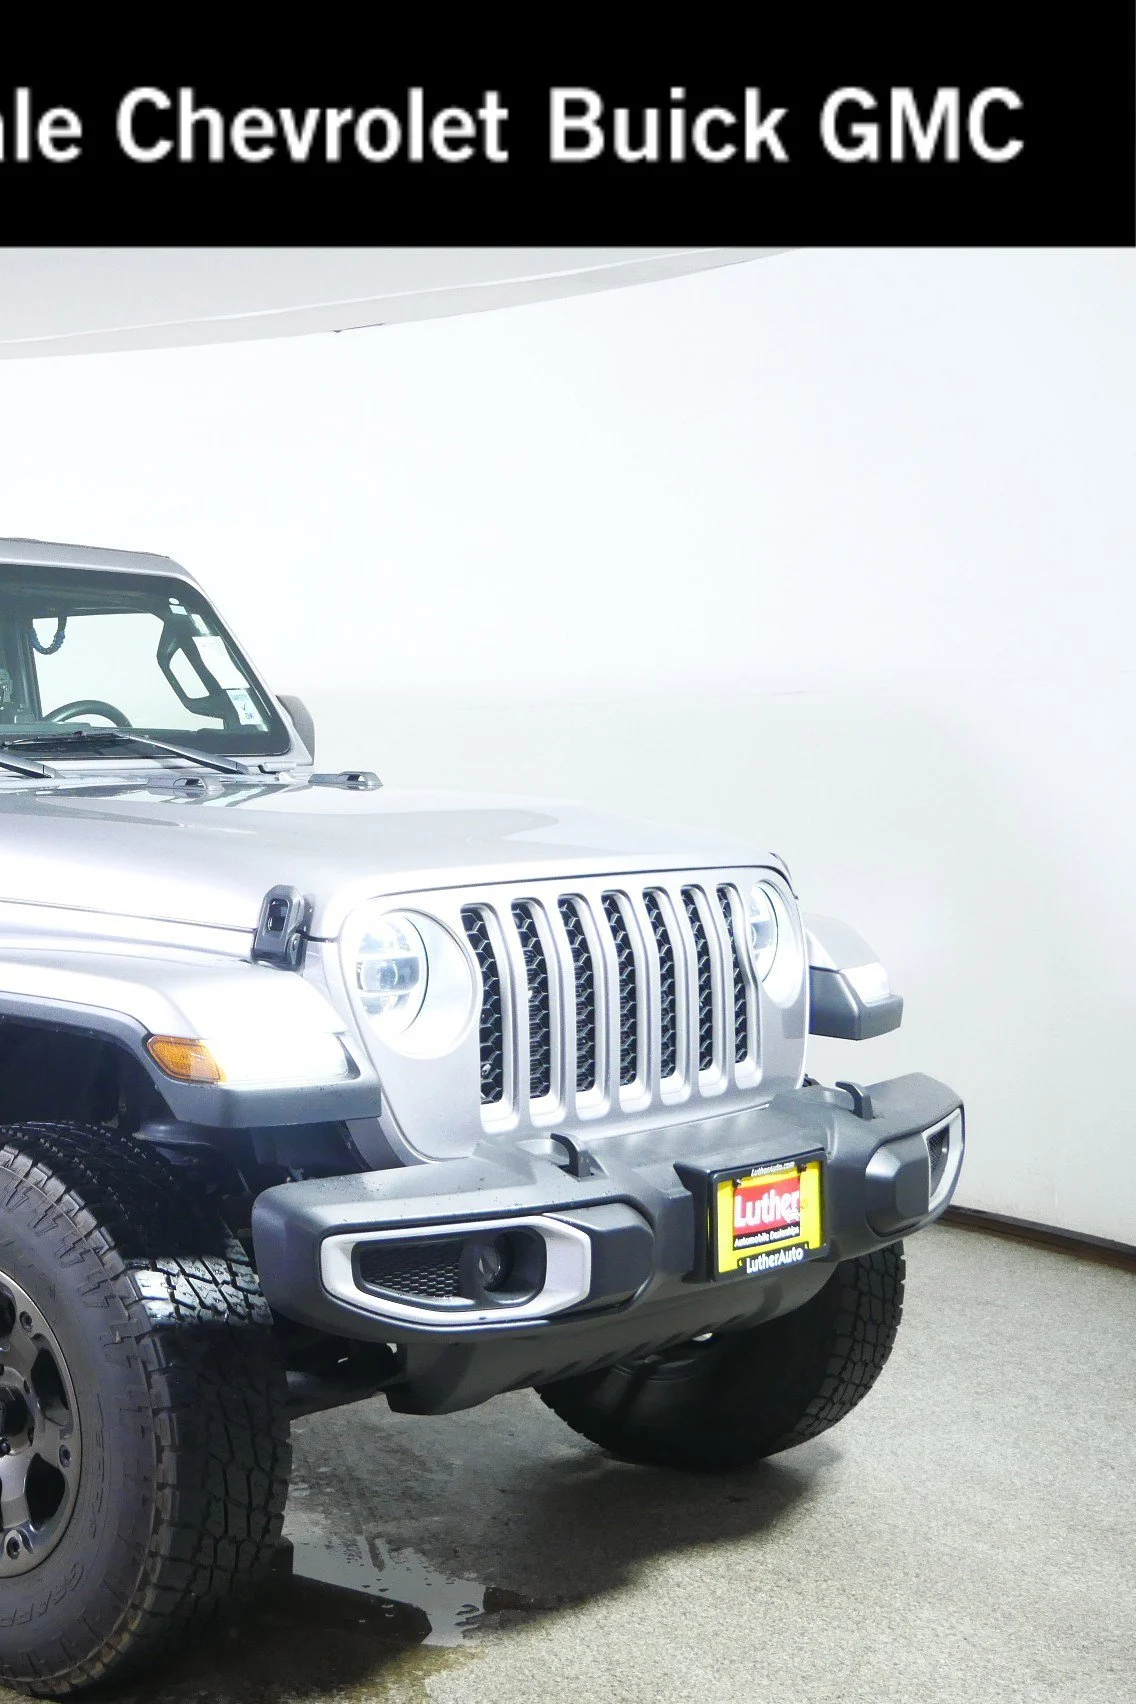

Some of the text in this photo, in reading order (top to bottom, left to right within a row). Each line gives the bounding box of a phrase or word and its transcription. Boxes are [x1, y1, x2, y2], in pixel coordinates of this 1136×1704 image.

[734, 1189, 800, 1228] Luther
[734, 1232, 770, 1248] Automobile
[746, 1246, 804, 1274] LutherAuto
